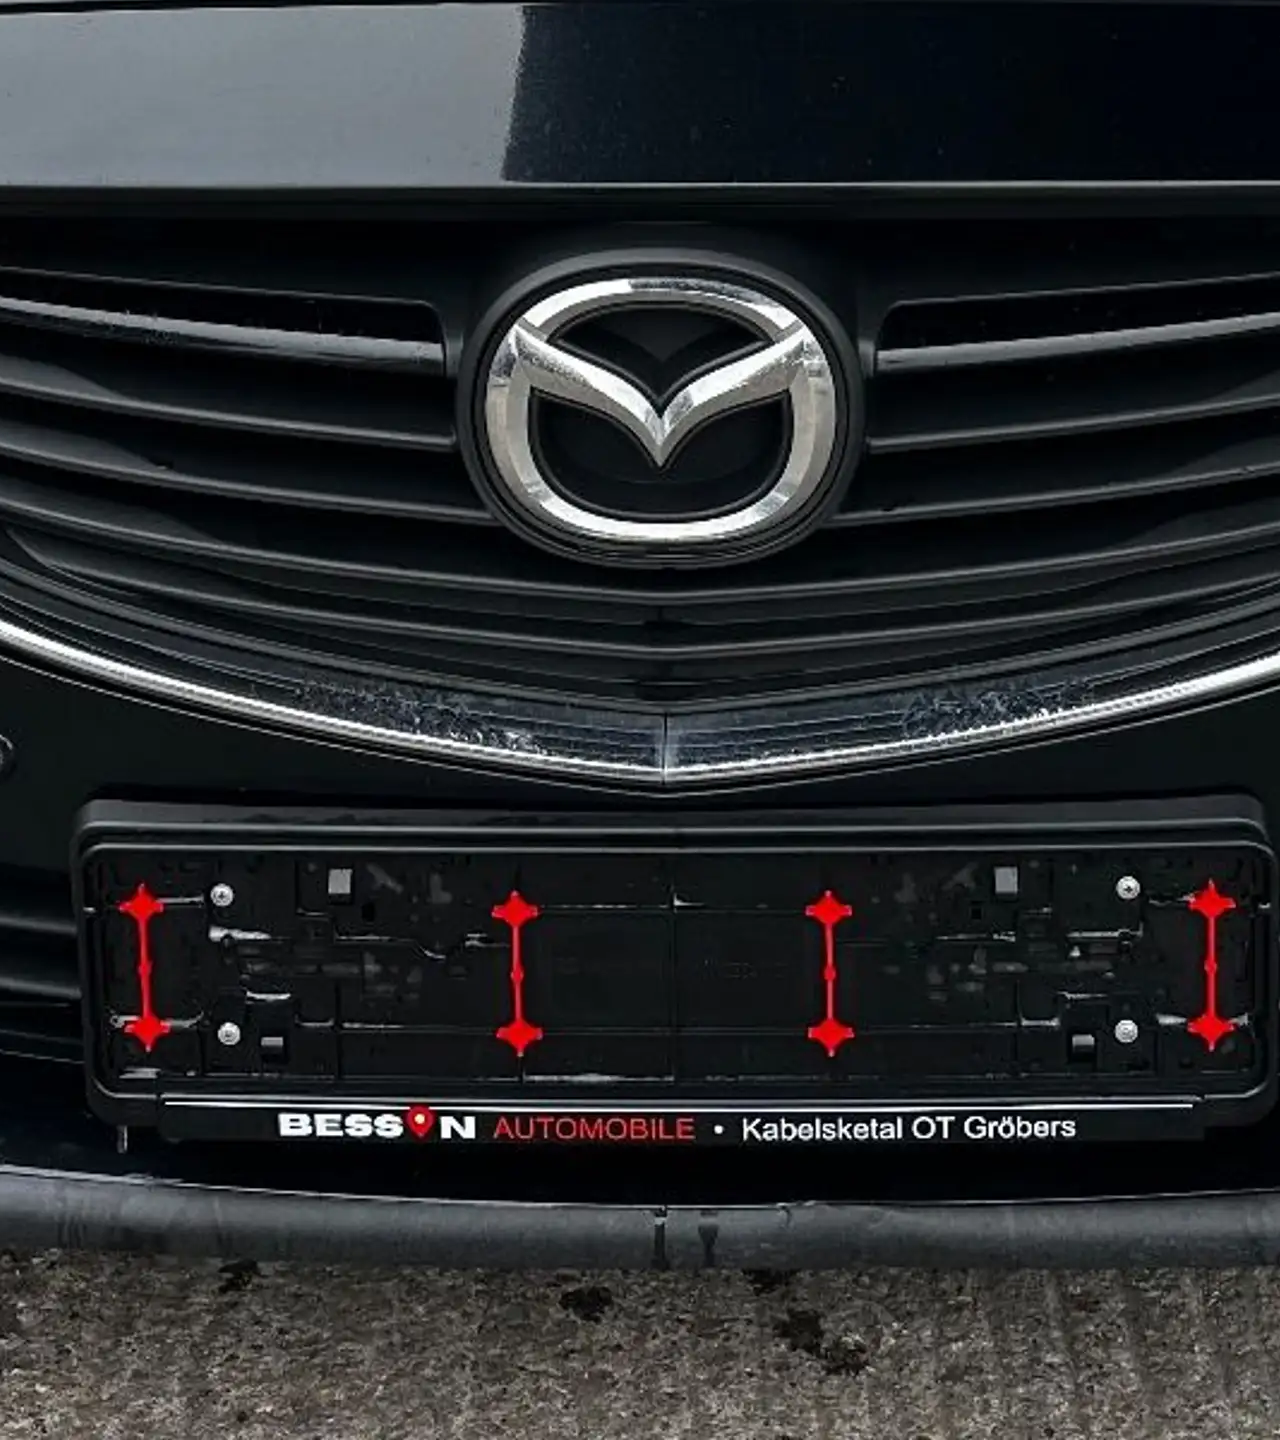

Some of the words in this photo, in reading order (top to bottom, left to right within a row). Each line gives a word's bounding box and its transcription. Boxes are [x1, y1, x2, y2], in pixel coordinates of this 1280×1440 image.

[493, 1116, 696, 1140] AUTOMOBILE
[742, 1117, 903, 1141] Kabelsketal
[911, 1116, 955, 1139] OT
[963, 1115, 1077, 1139] Gröbers
